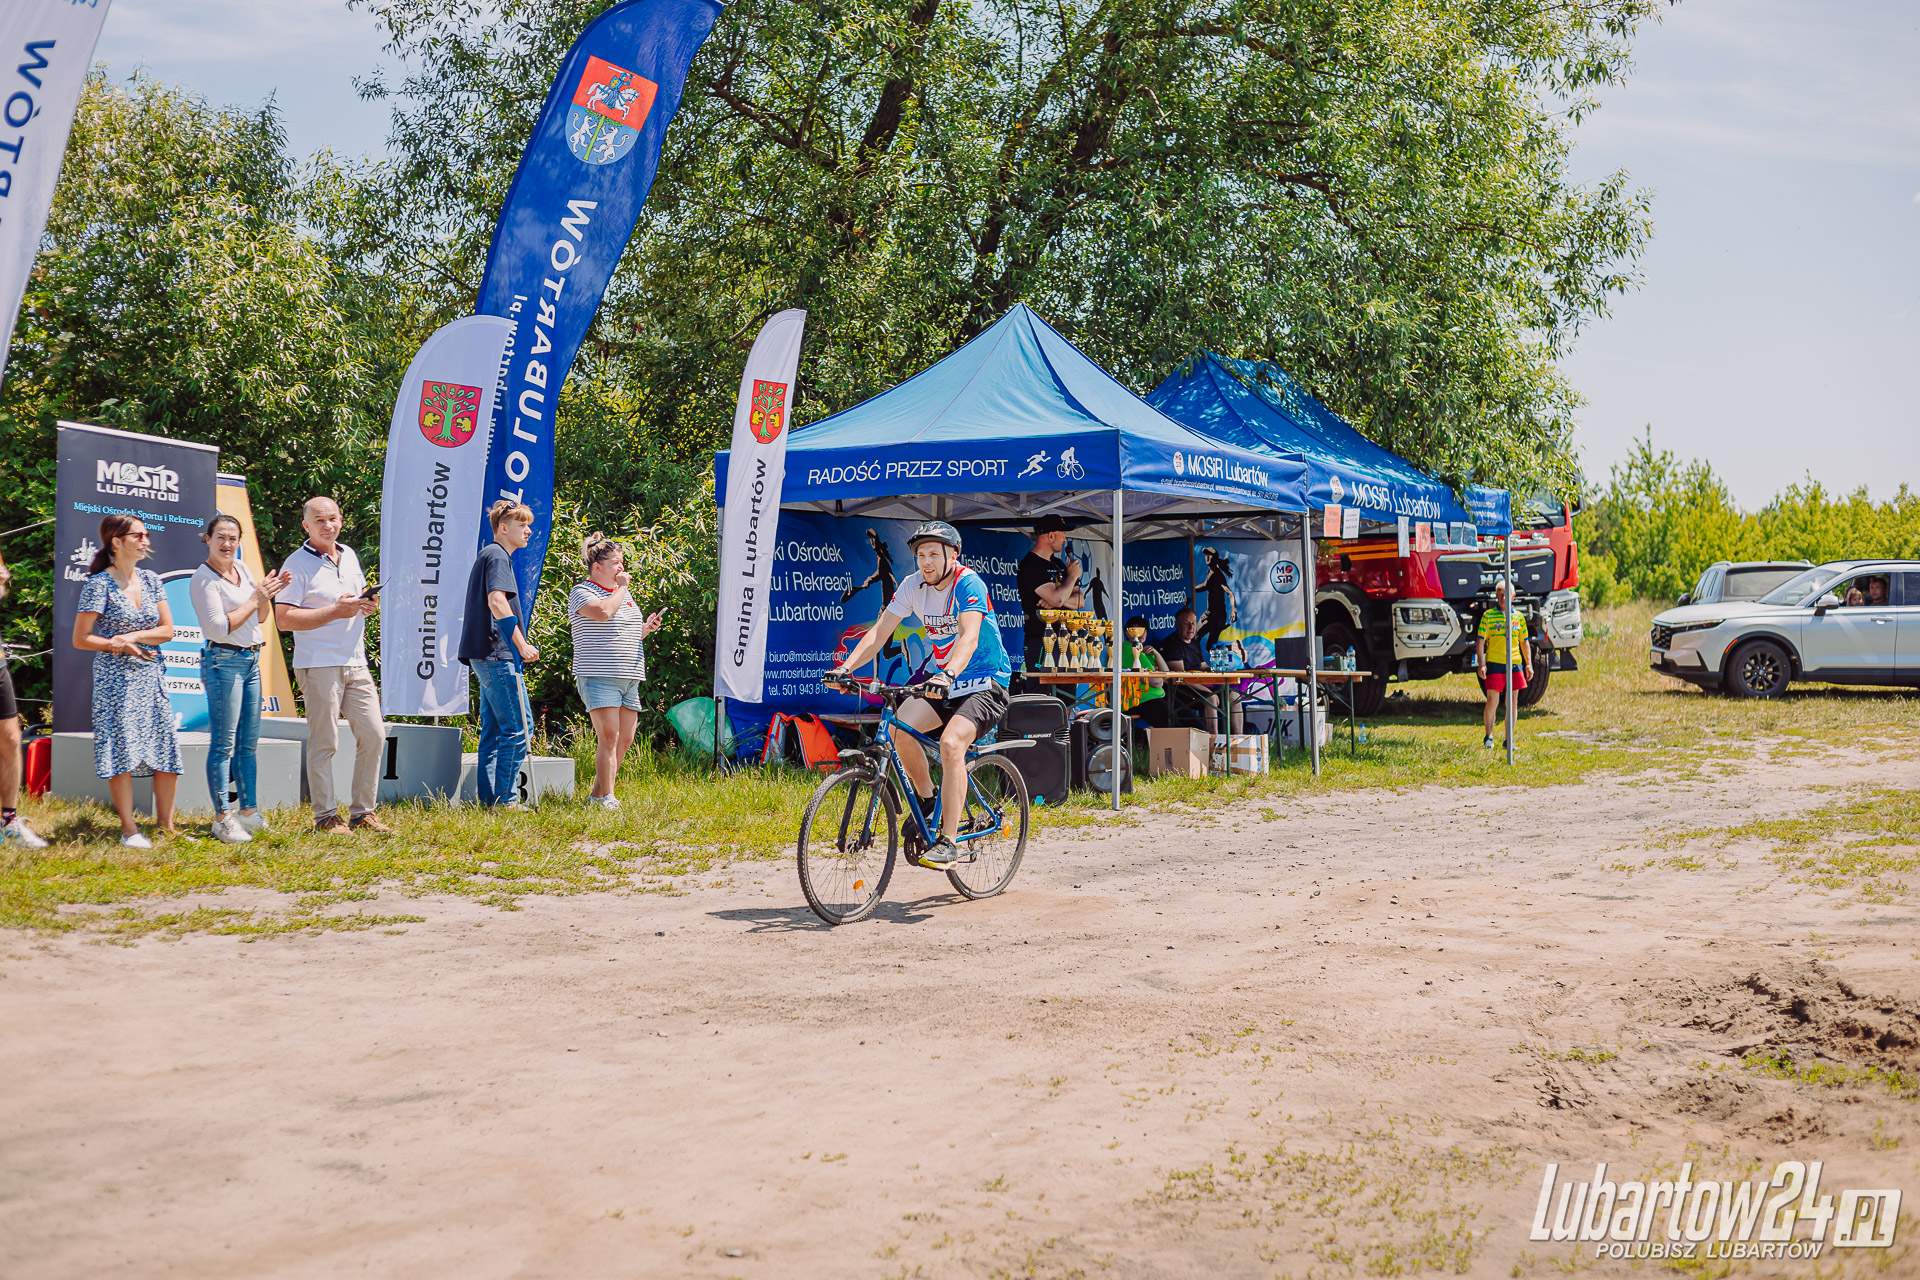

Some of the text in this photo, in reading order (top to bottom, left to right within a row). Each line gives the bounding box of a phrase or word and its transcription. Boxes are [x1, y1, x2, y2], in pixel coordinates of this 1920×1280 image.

[807, 460, 1009, 485] RADOŚĆ PRZEZ SPORT
[1188, 454, 1223, 479] MOSiR
[1225, 459, 1269, 487] Lubartów
[96, 482, 180, 503] LUBARTÓW
[73, 501, 101, 514] Miejski
[137, 510, 163, 522] Sportu
[169, 514, 205, 528] Rekreacji
[1392, 489, 1441, 520] Lubartów
[733, 458, 768, 667] Gmina Lubartów
[787, 541, 844, 563] Ośrodek
[416, 462, 452, 681] Gmina Lubartów
[990, 556, 1019, 577] Ośrod
[785, 570, 789, 591] i
[792, 571, 852, 593] Rekreacji
[995, 583, 1022, 603] Rekre
[768, 600, 844, 622] Lubartowie
[163, 655, 200, 666] KREACJA
[166, 681, 201, 691] YSTYKA
[768, 684, 781, 696] tel.
[782, 684, 797, 696] 501
[799, 683, 814, 695] 943
[383, 736, 399, 780] 1
